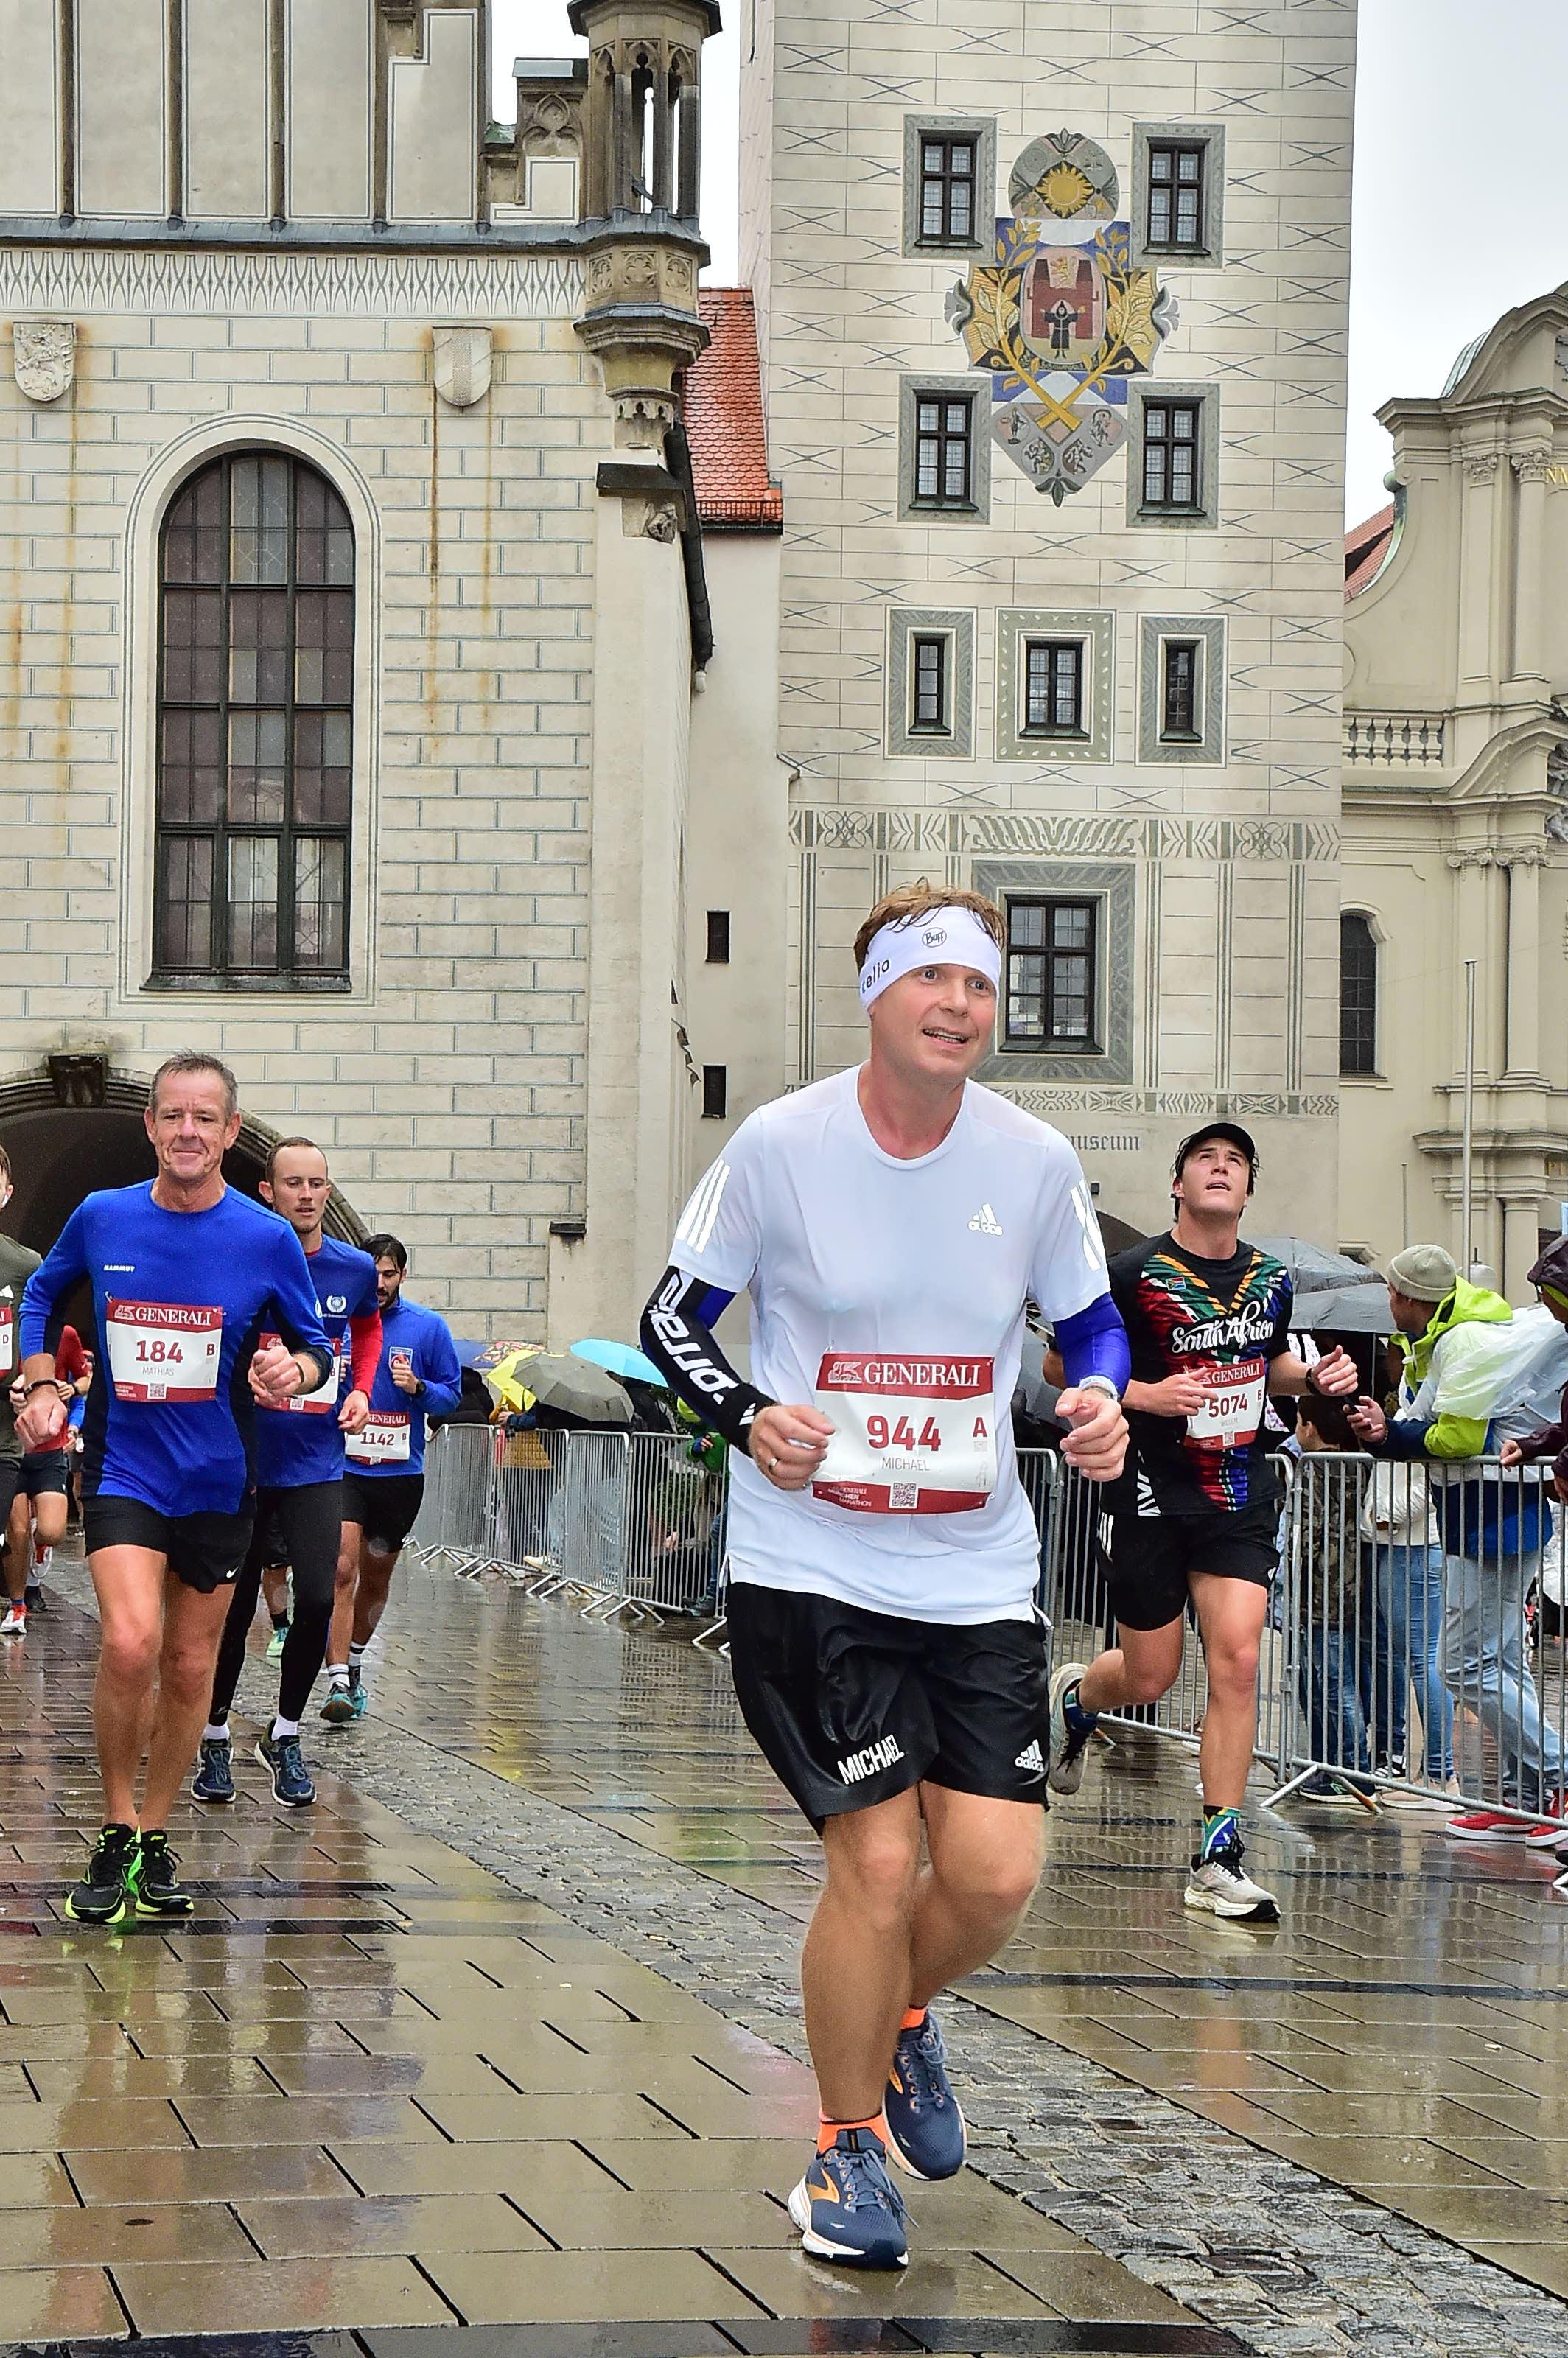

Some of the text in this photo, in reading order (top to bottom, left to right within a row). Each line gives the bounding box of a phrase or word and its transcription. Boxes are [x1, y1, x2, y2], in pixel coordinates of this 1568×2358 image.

[925, 931, 945, 945] Buff
[136, 1306, 211, 1326] GENERALI
[1172, 1300, 1273, 1354] South Africa
[3, 1334, 8, 1344] D
[136, 1340, 183, 1363] 184
[206, 1343, 215, 1356] B
[142, 1367, 175, 1376] MATHIAS
[864, 1362, 981, 1387] GENERALI
[1211, 1362, 1261, 1384] GENERALI
[1257, 1389, 1262, 1401] B
[1208, 1393, 1248, 1418] 5074
[867, 1416, 942, 1452] 944
[973, 1417, 988, 1438] A
[360, 1432, 394, 1445] 1142
[881, 1457, 931, 1472] MICHAEL
[837, 1734, 905, 1785] MICHAEL
